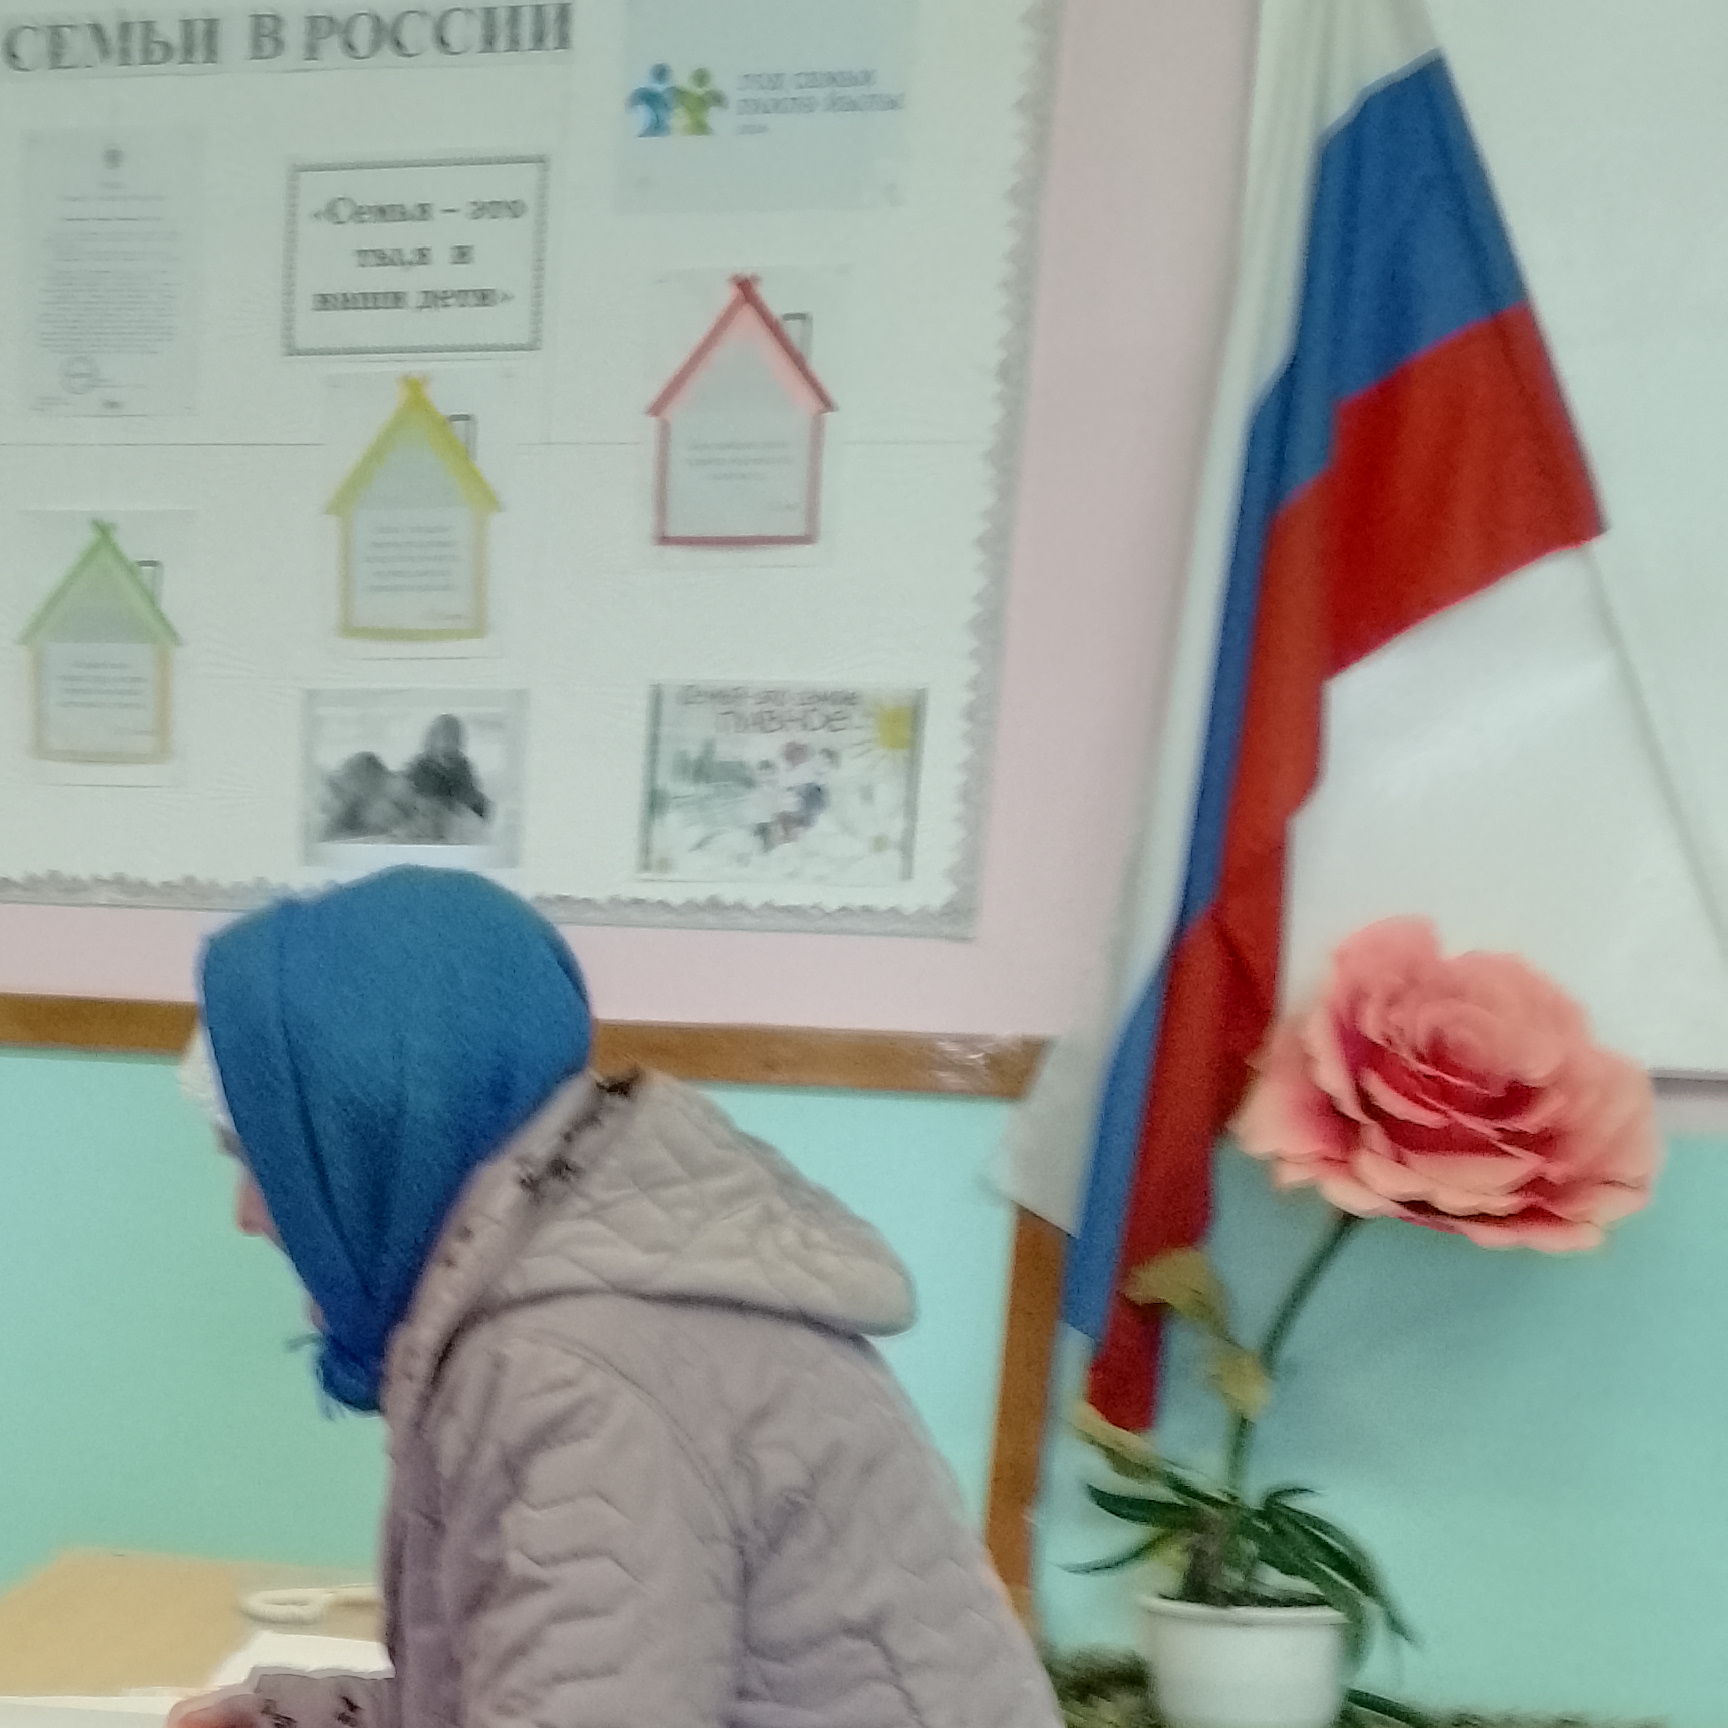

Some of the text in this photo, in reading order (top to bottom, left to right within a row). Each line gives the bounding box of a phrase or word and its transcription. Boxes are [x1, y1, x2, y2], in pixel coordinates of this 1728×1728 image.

[0, 16, 222, 73] СЕМЬИ
[248, 12, 284, 62] В
[303, 1, 571, 62] РОССИИ
